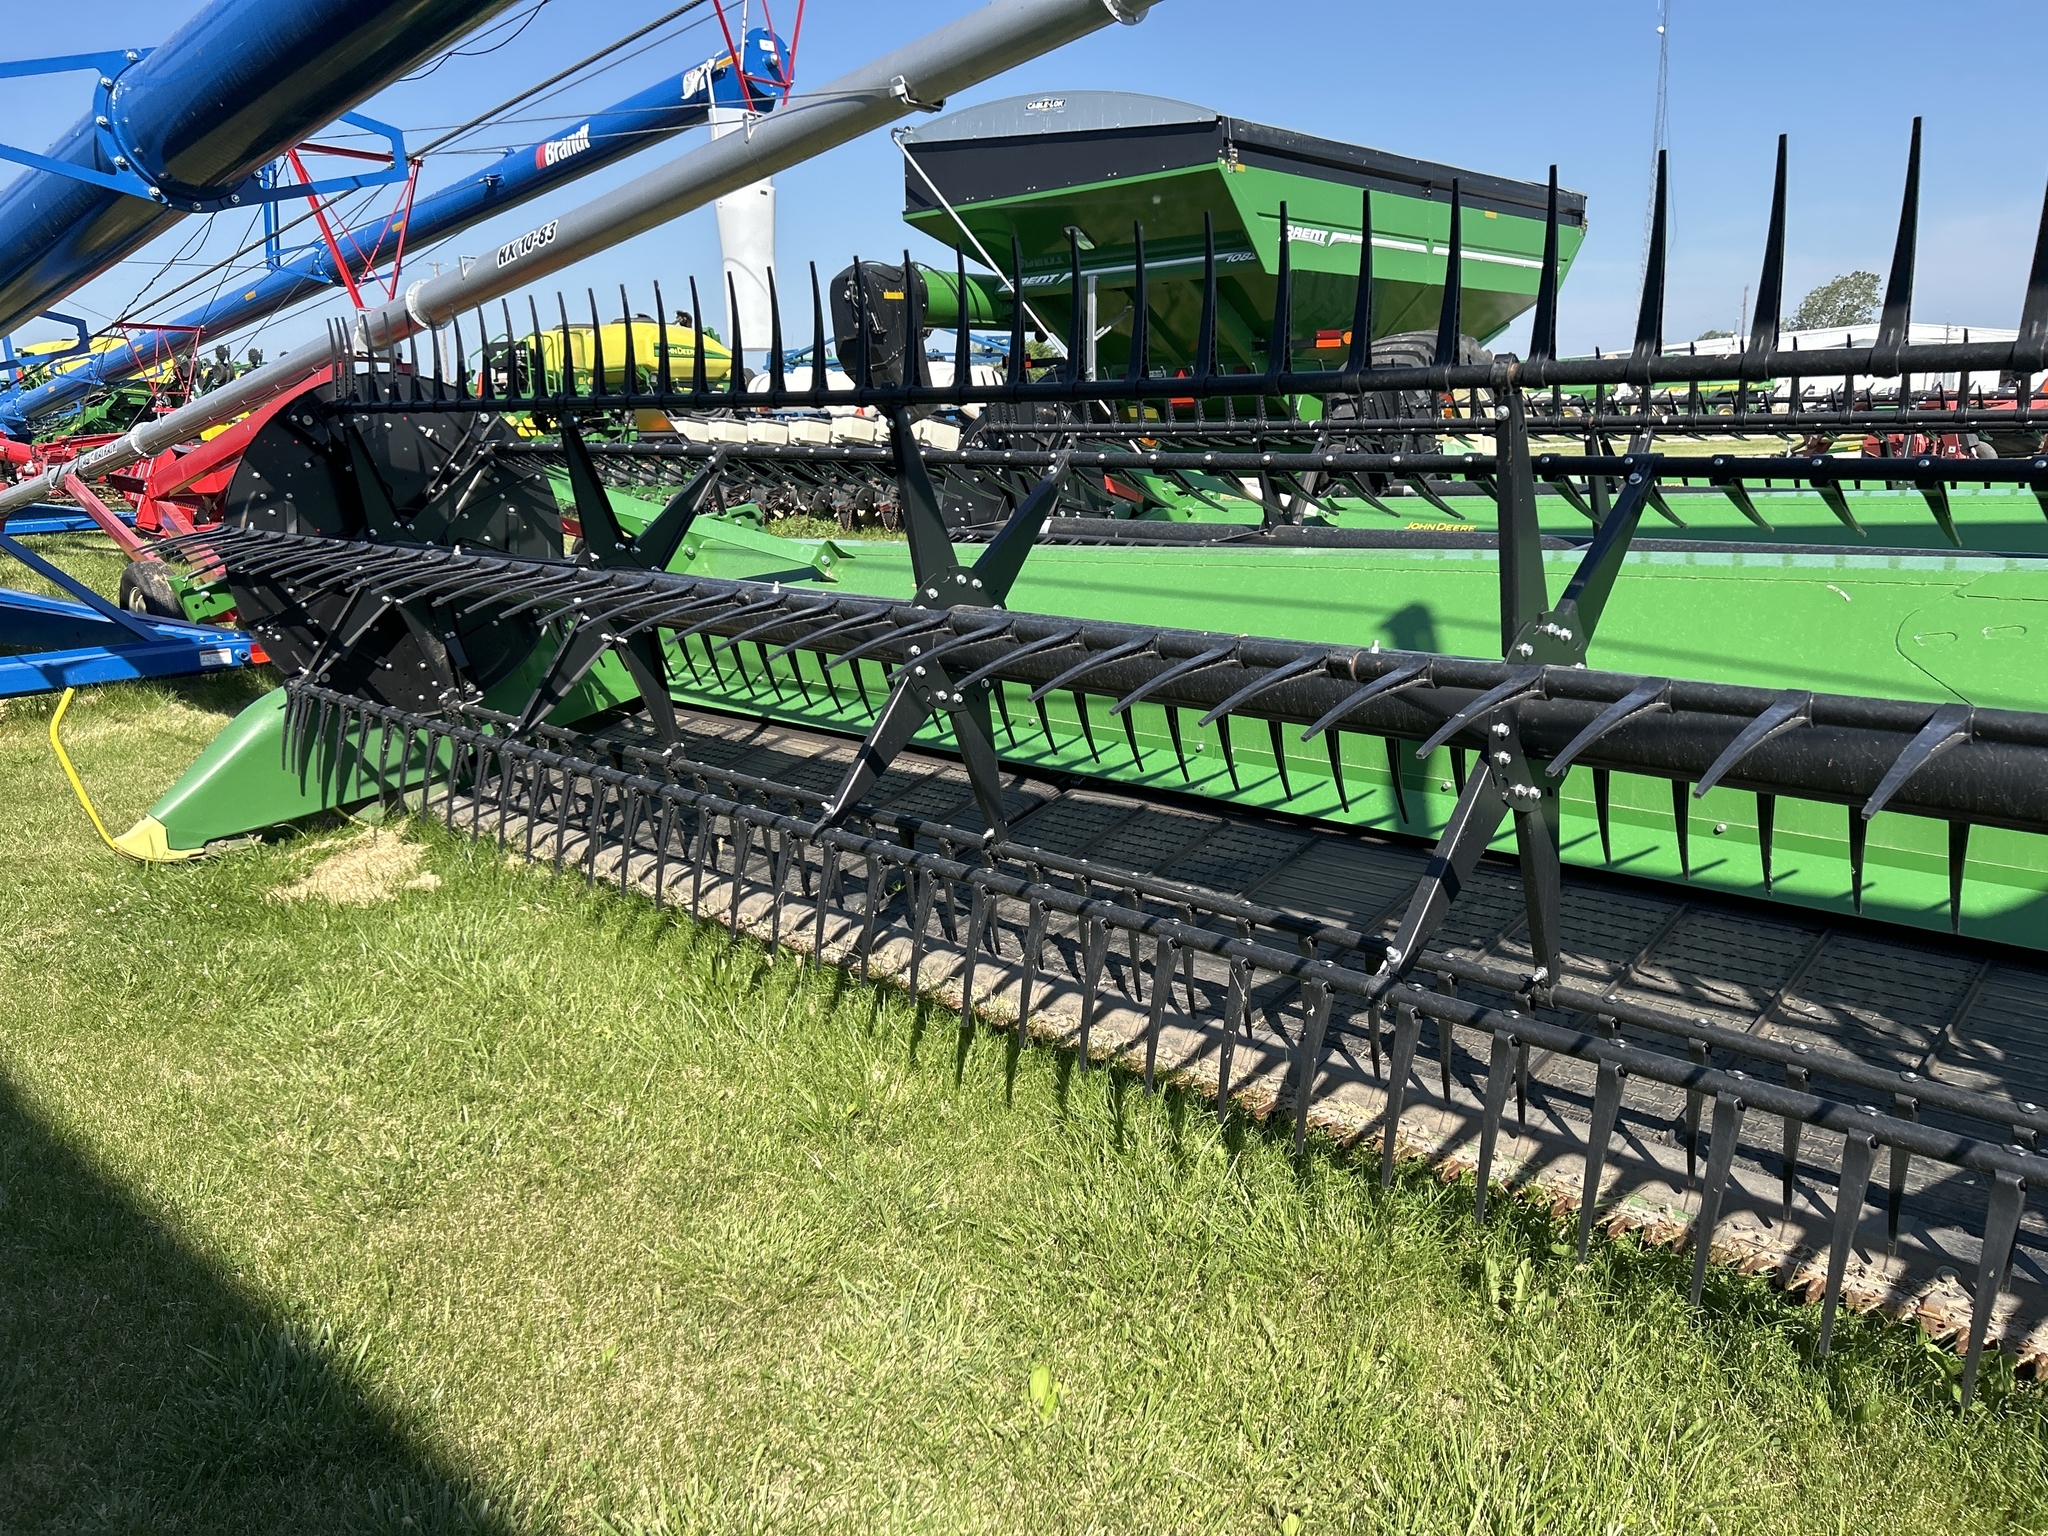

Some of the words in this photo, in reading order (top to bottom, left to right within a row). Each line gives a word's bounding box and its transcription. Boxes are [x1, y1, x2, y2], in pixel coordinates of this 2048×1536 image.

[544, 123, 590, 167] Brandt
[498, 239, 520, 267] HX
[520, 220, 557, 255] 10-83
[1404, 521, 1436, 531] JOHN
